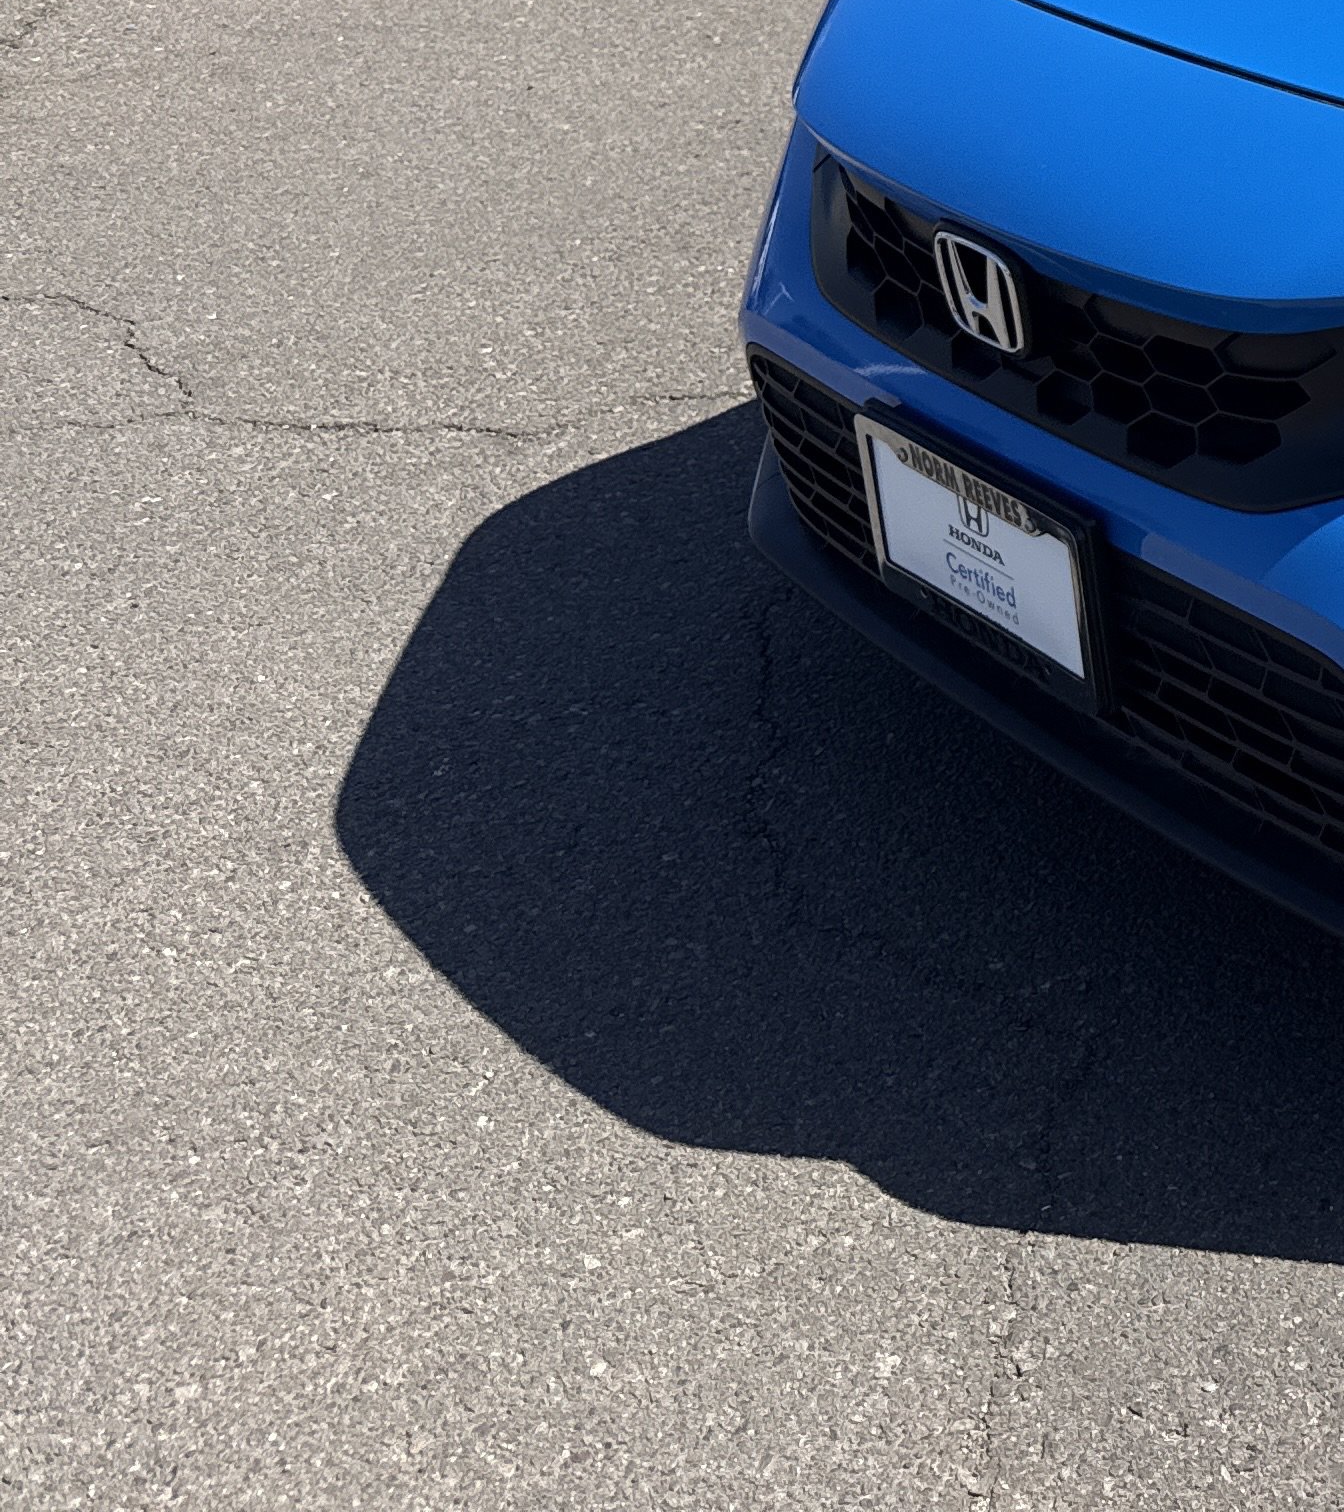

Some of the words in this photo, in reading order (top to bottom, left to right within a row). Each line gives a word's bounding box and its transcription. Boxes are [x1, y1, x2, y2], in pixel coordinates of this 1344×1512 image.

[908, 443, 959, 494] NORM
[961, 473, 1022, 527] REEVES
[948, 524, 1006, 567] HONDA
[945, 551, 1017, 609] Certified
